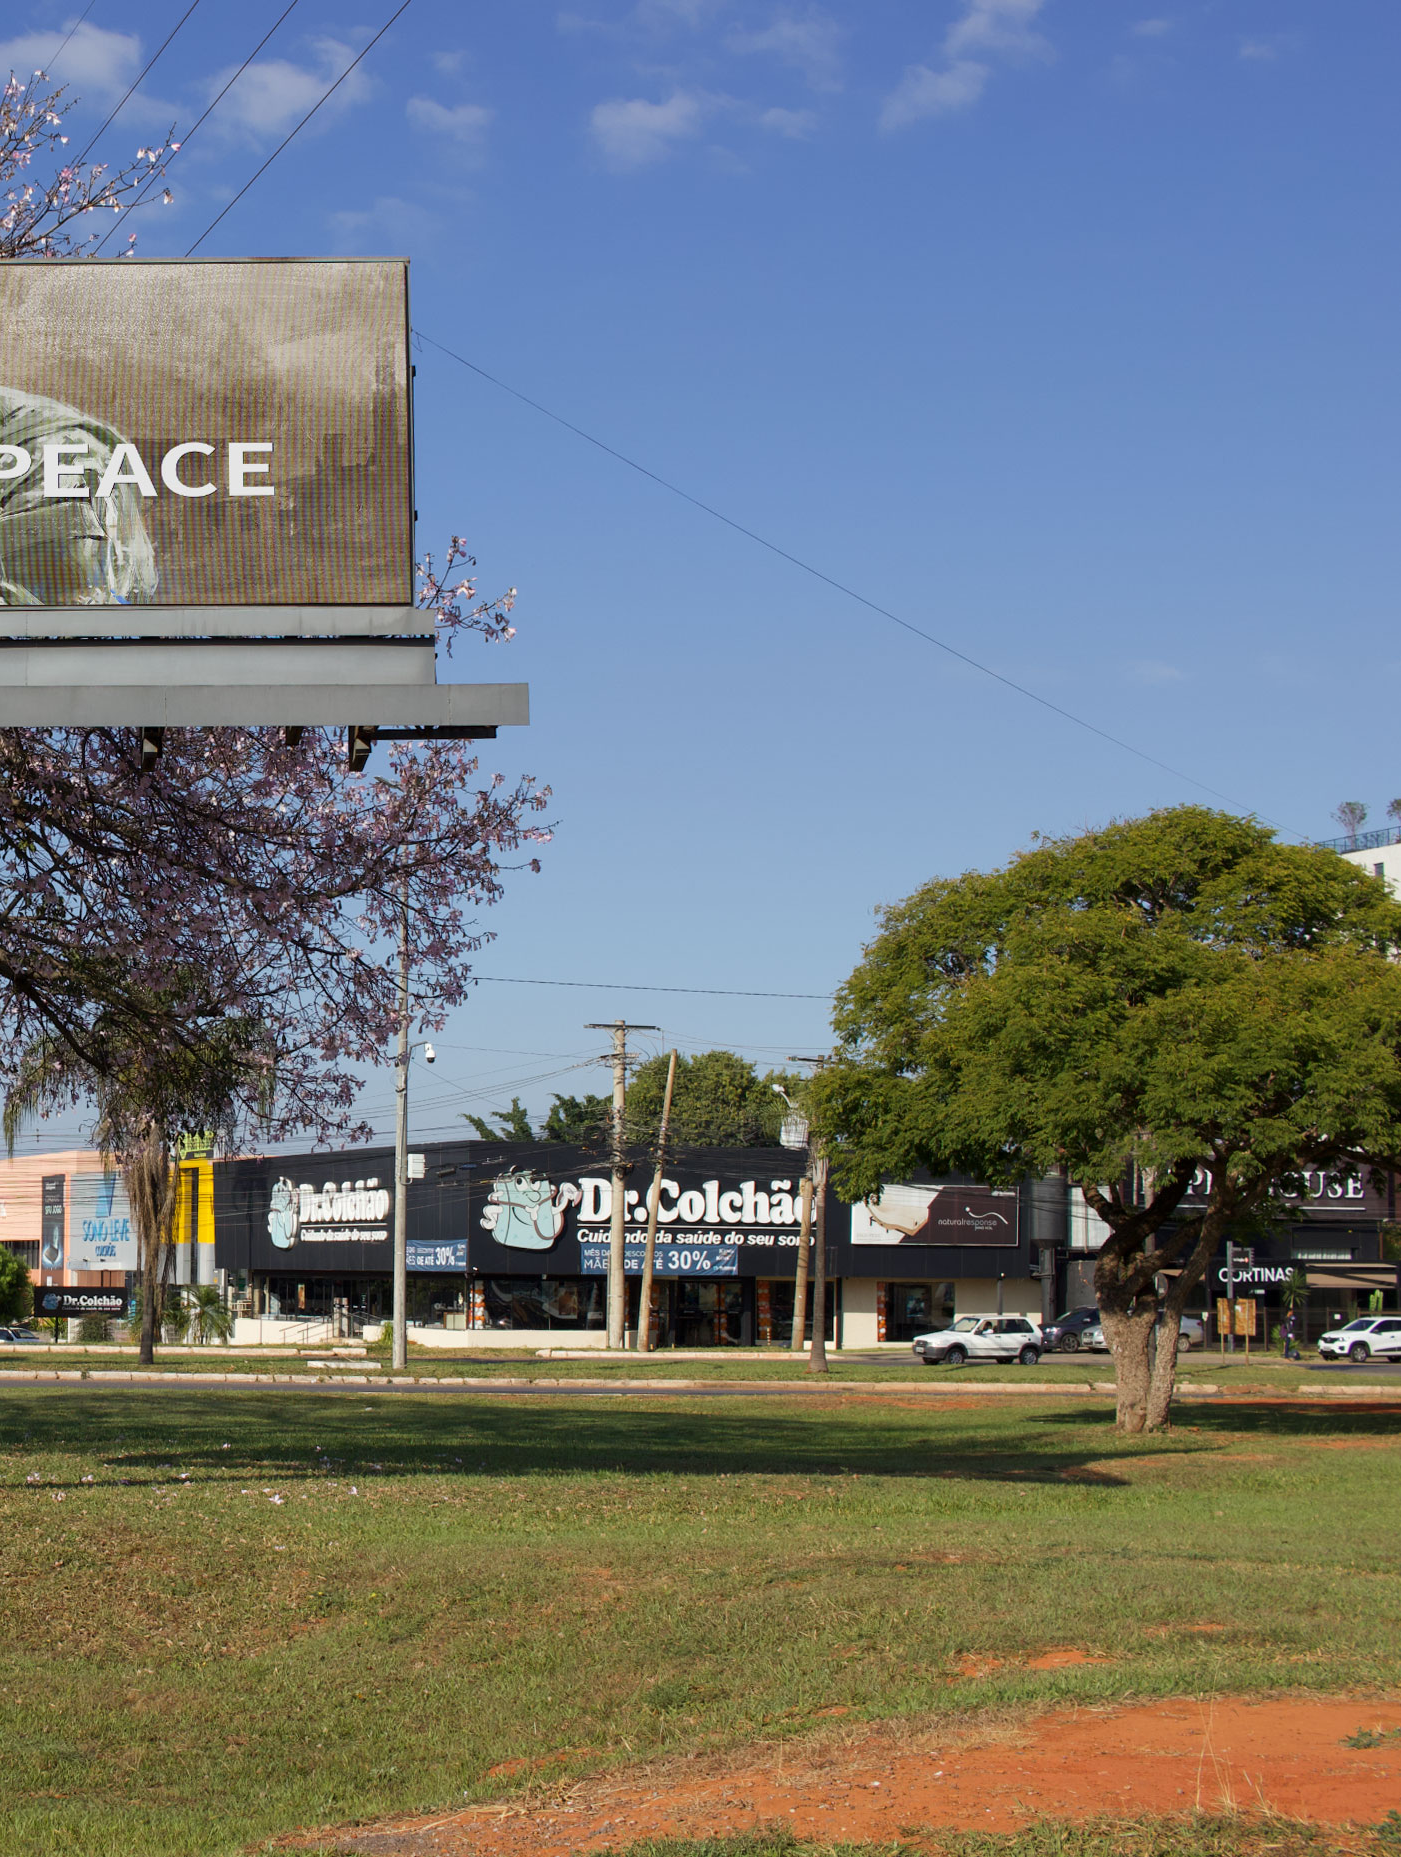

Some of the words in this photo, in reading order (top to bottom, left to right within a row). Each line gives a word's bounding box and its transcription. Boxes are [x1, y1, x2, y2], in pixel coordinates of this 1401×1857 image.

[82, 1219, 108, 1242] SONO
[110, 1218, 130, 1242] LEVE
[576, 1228, 648, 1244] Cuidndo
[655, 1230, 672, 1244] da
[675, 1230, 722, 1245] saúde
[724, 1231, 744, 1246] do
[747, 1234, 774, 1247] seu
[584, 1248, 600, 1257] MÊS
[667, 1250, 711, 1270] 30%
[624, 1259, 638, 1269] DE
[62, 1294, 123, 1306] Dr.Colchão
